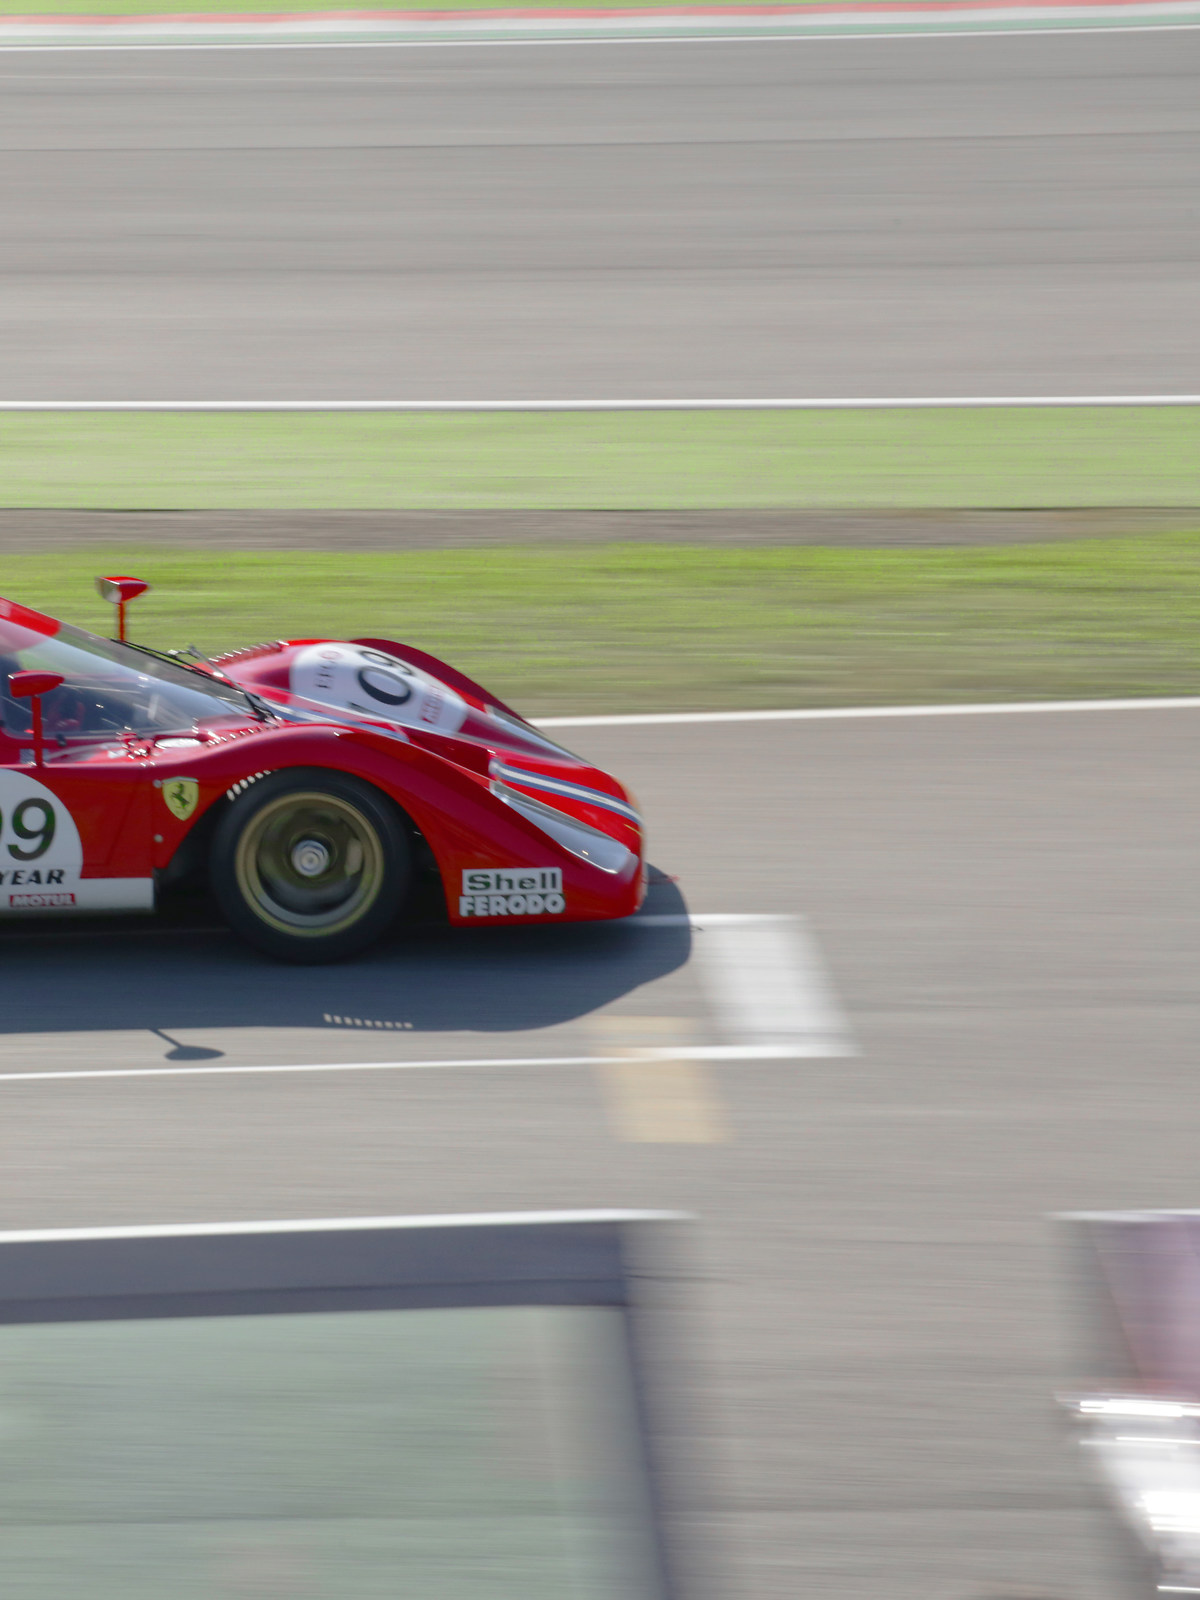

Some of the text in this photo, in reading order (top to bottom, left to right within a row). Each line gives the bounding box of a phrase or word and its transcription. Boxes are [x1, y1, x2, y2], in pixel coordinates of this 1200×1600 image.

[467, 872, 557, 891] Shell
[13, 894, 73, 907] MOTUL
[459, 894, 566, 917] FERODO
